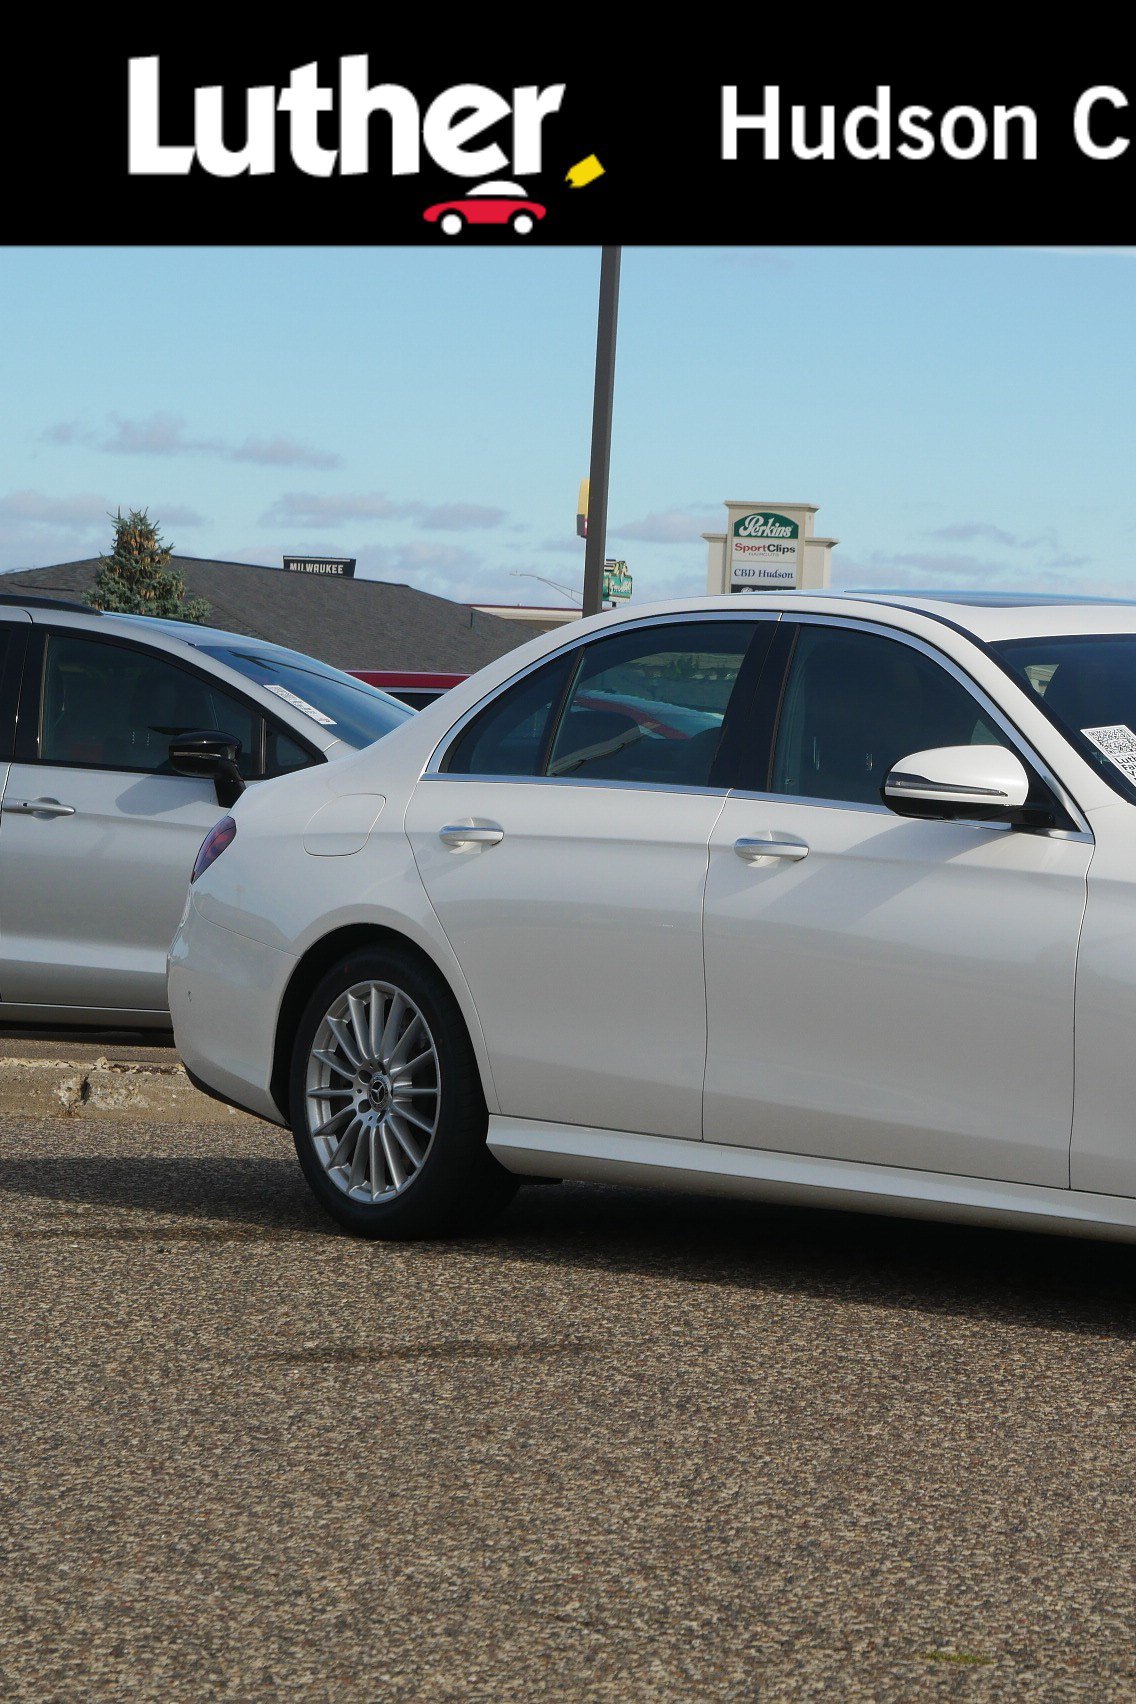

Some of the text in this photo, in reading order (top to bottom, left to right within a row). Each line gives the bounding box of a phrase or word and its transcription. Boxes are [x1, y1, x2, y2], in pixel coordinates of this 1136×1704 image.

[738, 514, 792, 538] Perkins
[289, 562, 344, 575] MILWAUKEE
[733, 568, 794, 579] CBD Hudson
